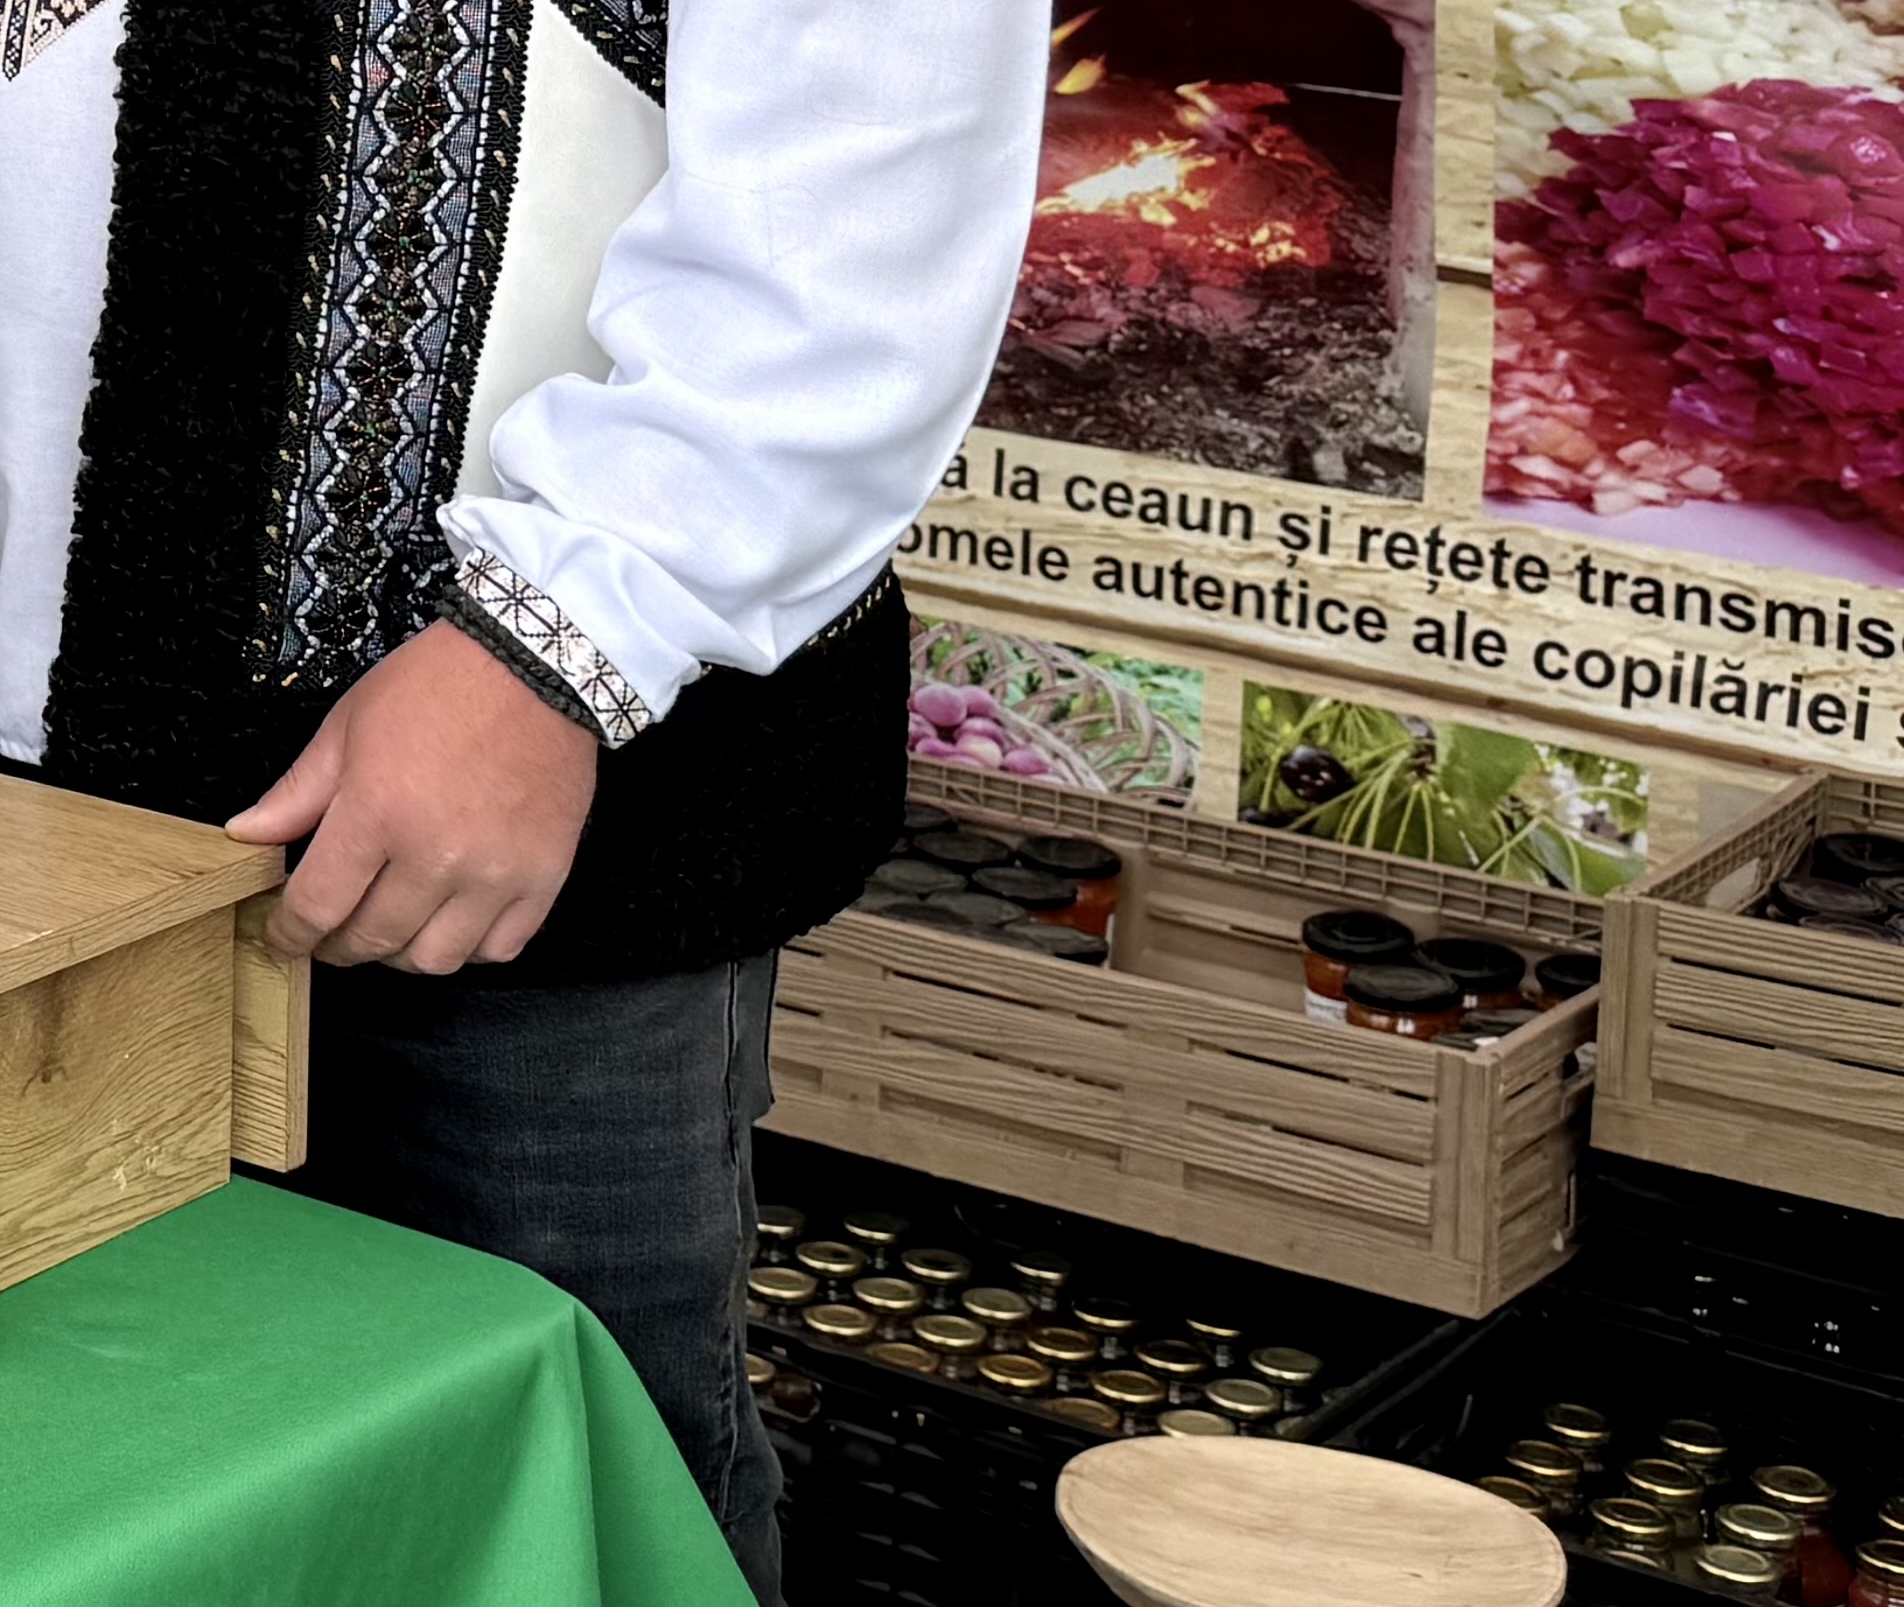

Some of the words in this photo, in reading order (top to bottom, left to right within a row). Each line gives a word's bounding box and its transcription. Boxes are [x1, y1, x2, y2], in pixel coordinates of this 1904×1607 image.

[993, 441, 1060, 506] la
[1064, 471, 1256, 545] ceaun
[1276, 504, 1333, 566] și
[1355, 523, 1552, 596] rețete
[1574, 559, 1904, 664] transmis
[1092, 554, 1391, 646] autentice
[1411, 606, 1510, 671] ale
[1531, 638, 1872, 746] copilăriei
